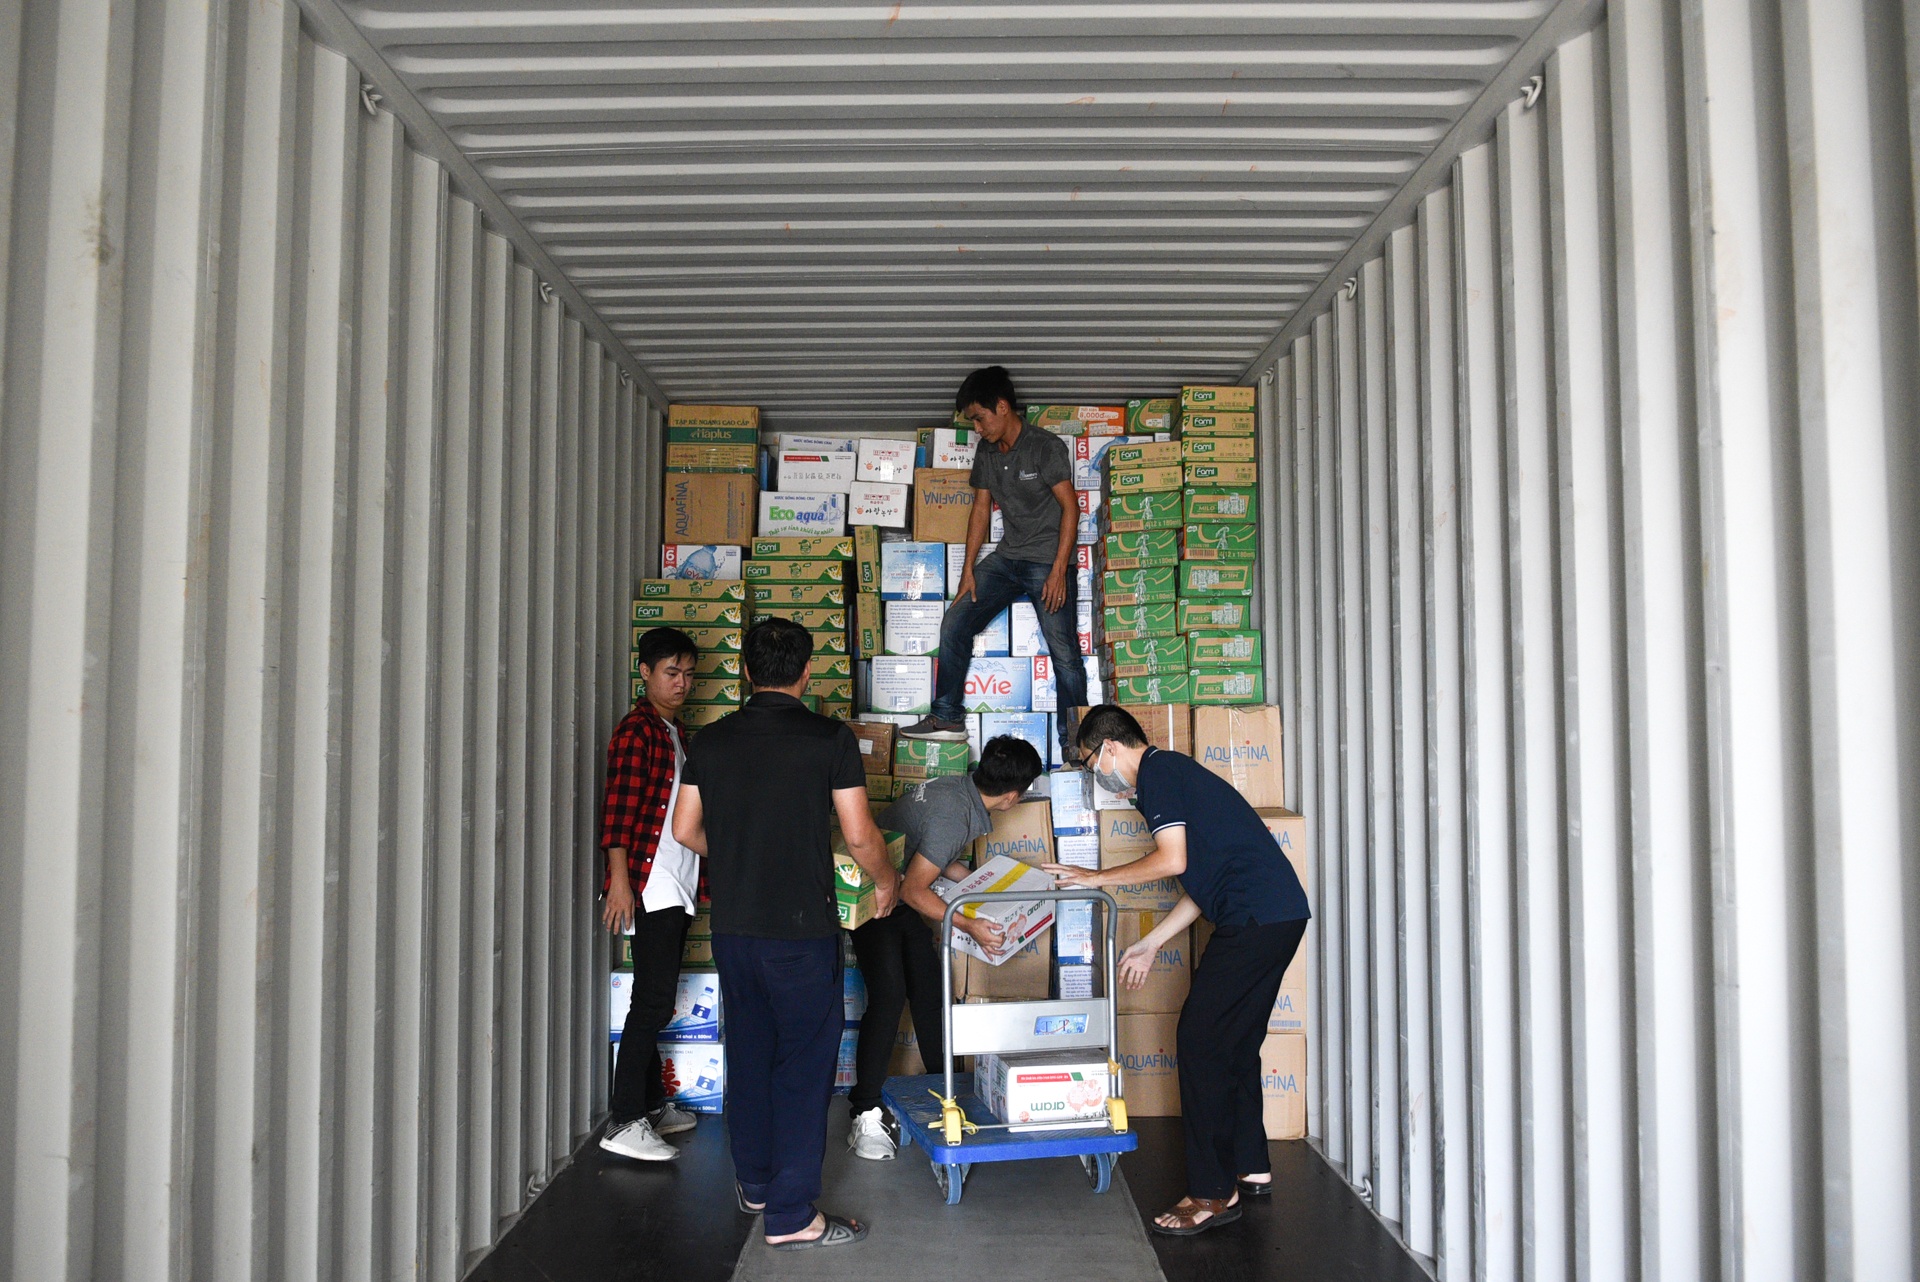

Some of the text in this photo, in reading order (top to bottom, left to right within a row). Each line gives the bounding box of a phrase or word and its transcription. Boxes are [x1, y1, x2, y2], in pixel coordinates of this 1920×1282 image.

[1077, 442, 1087, 453] 6
[674, 480, 689, 537] AQUAFINA
[1078, 496, 1087, 507] 6
[769, 505, 825, 523] Eco aqua
[665, 549, 675, 561] 6
[1077, 551, 1087, 562] 6
[755, 590, 769, 598] ami
[1036, 661, 1046, 673] 6
[963, 674, 1011, 695] aVie
[1204, 744, 1271, 764] AQUAFINA
[1111, 820, 1151, 837] AQUA
[985, 837, 1047, 859] AQUAFINA
[1116, 878, 1180, 895] AQUAFINA
[1261, 1074, 1298, 1093] FINA
[1030, 1101, 1065, 1112] aram
